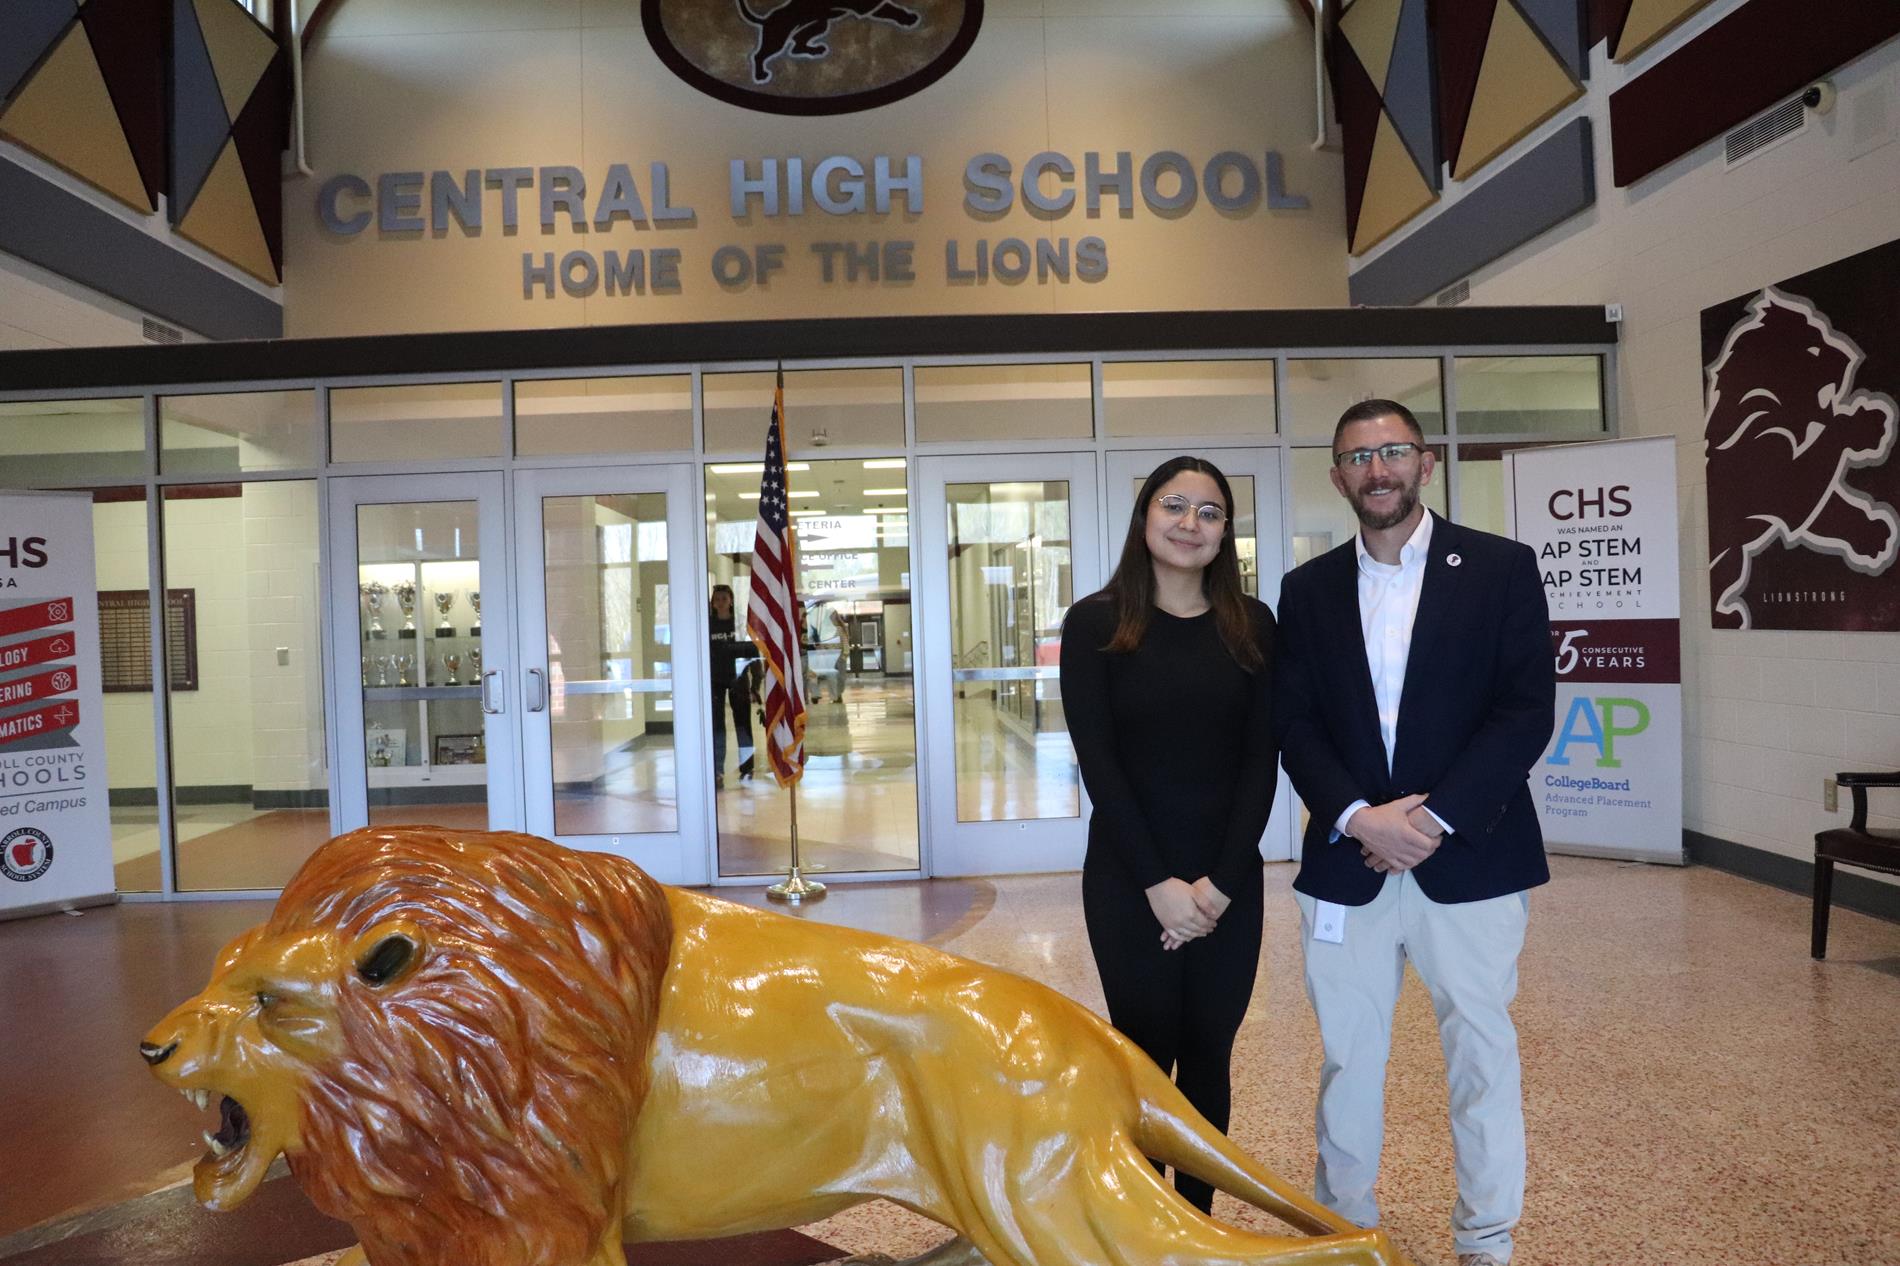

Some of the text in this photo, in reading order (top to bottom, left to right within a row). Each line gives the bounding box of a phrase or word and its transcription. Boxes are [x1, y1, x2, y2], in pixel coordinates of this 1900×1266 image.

[318, 151, 1310, 237] CENTRAL HIGH SCHOOL
[522, 236, 1108, 299] HOME OF THE LIONS
[1548, 485, 1632, 521] CHS
[1557, 524, 1624, 535] WAS NAMED AN
[1541, 537, 1641, 560] AP STEM
[808, 580, 856, 589] CENTER
[1543, 567, 1642, 588] AP STEM
[1550, 589, 1642, 598] CHIEVEMENT
[1763, 591, 1845, 603] LIONSTRONG
[1558, 600, 1641, 610] CHOOL
[1581, 646, 1645, 654] CONSECUTIVE
[1583, 656, 1646, 668] YEARS
[1545, 697, 1652, 769] AP
[25, 752, 85, 767] COUNTY
[1545, 775, 1630, 792] CollegeBoard
[24, 796, 87, 814] Campus
[1545, 793, 1652, 809] Advanced Placement
[1545, 805, 1588, 818] Program
